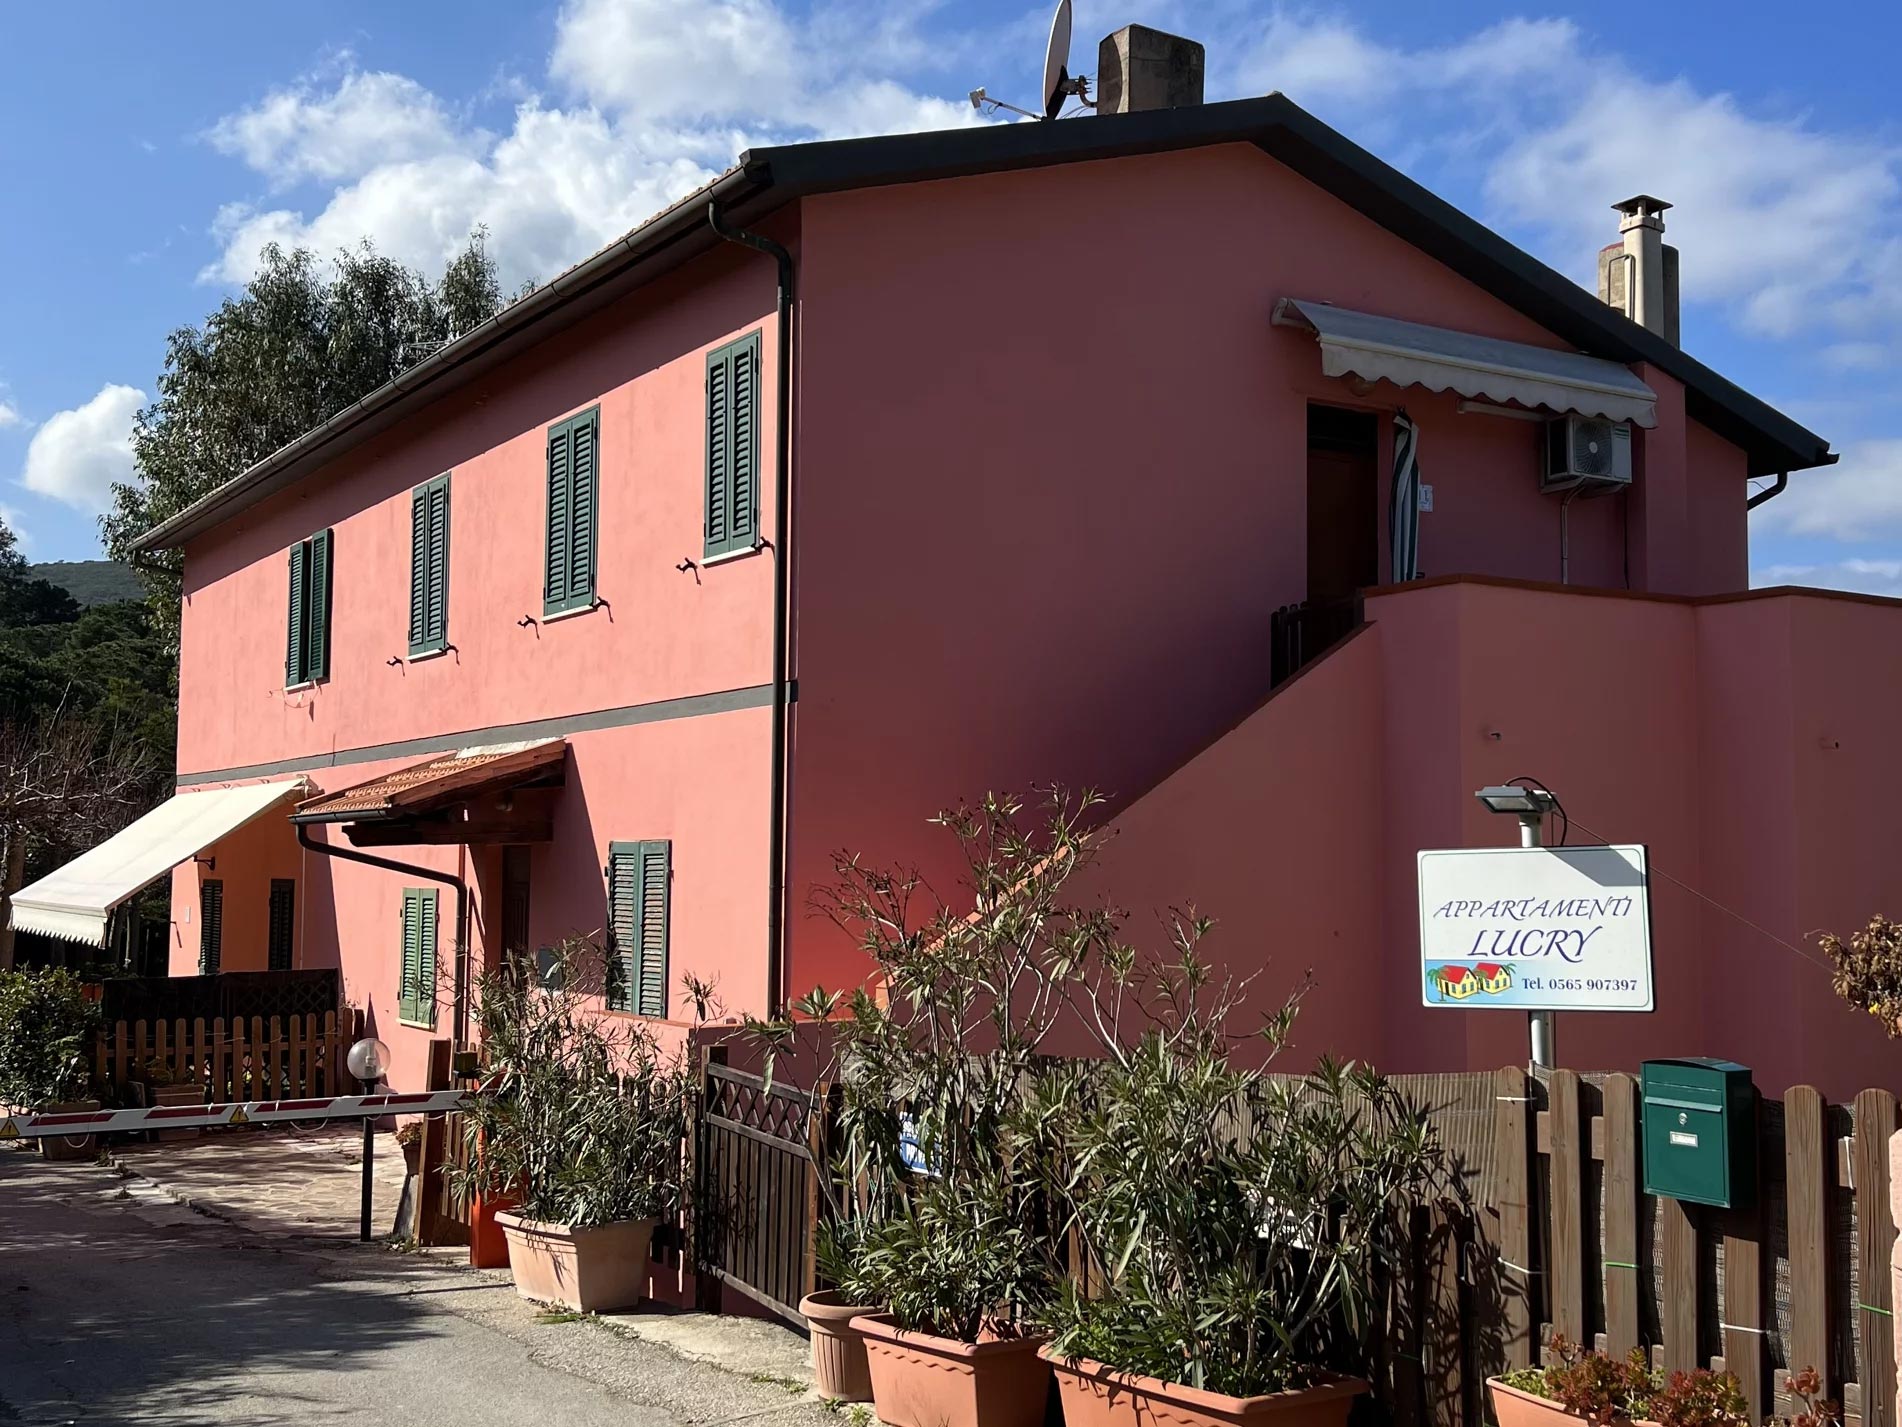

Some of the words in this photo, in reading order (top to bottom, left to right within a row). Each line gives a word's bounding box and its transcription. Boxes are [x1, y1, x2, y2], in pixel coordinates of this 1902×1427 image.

[1433, 896, 1632, 921] APPARTAMENTI
[1467, 926, 1603, 963] LUCRY
[1522, 978, 1544, 990] Tel.
[1549, 979, 1582, 990] 0565
[1587, 979, 1638, 991] 907397
